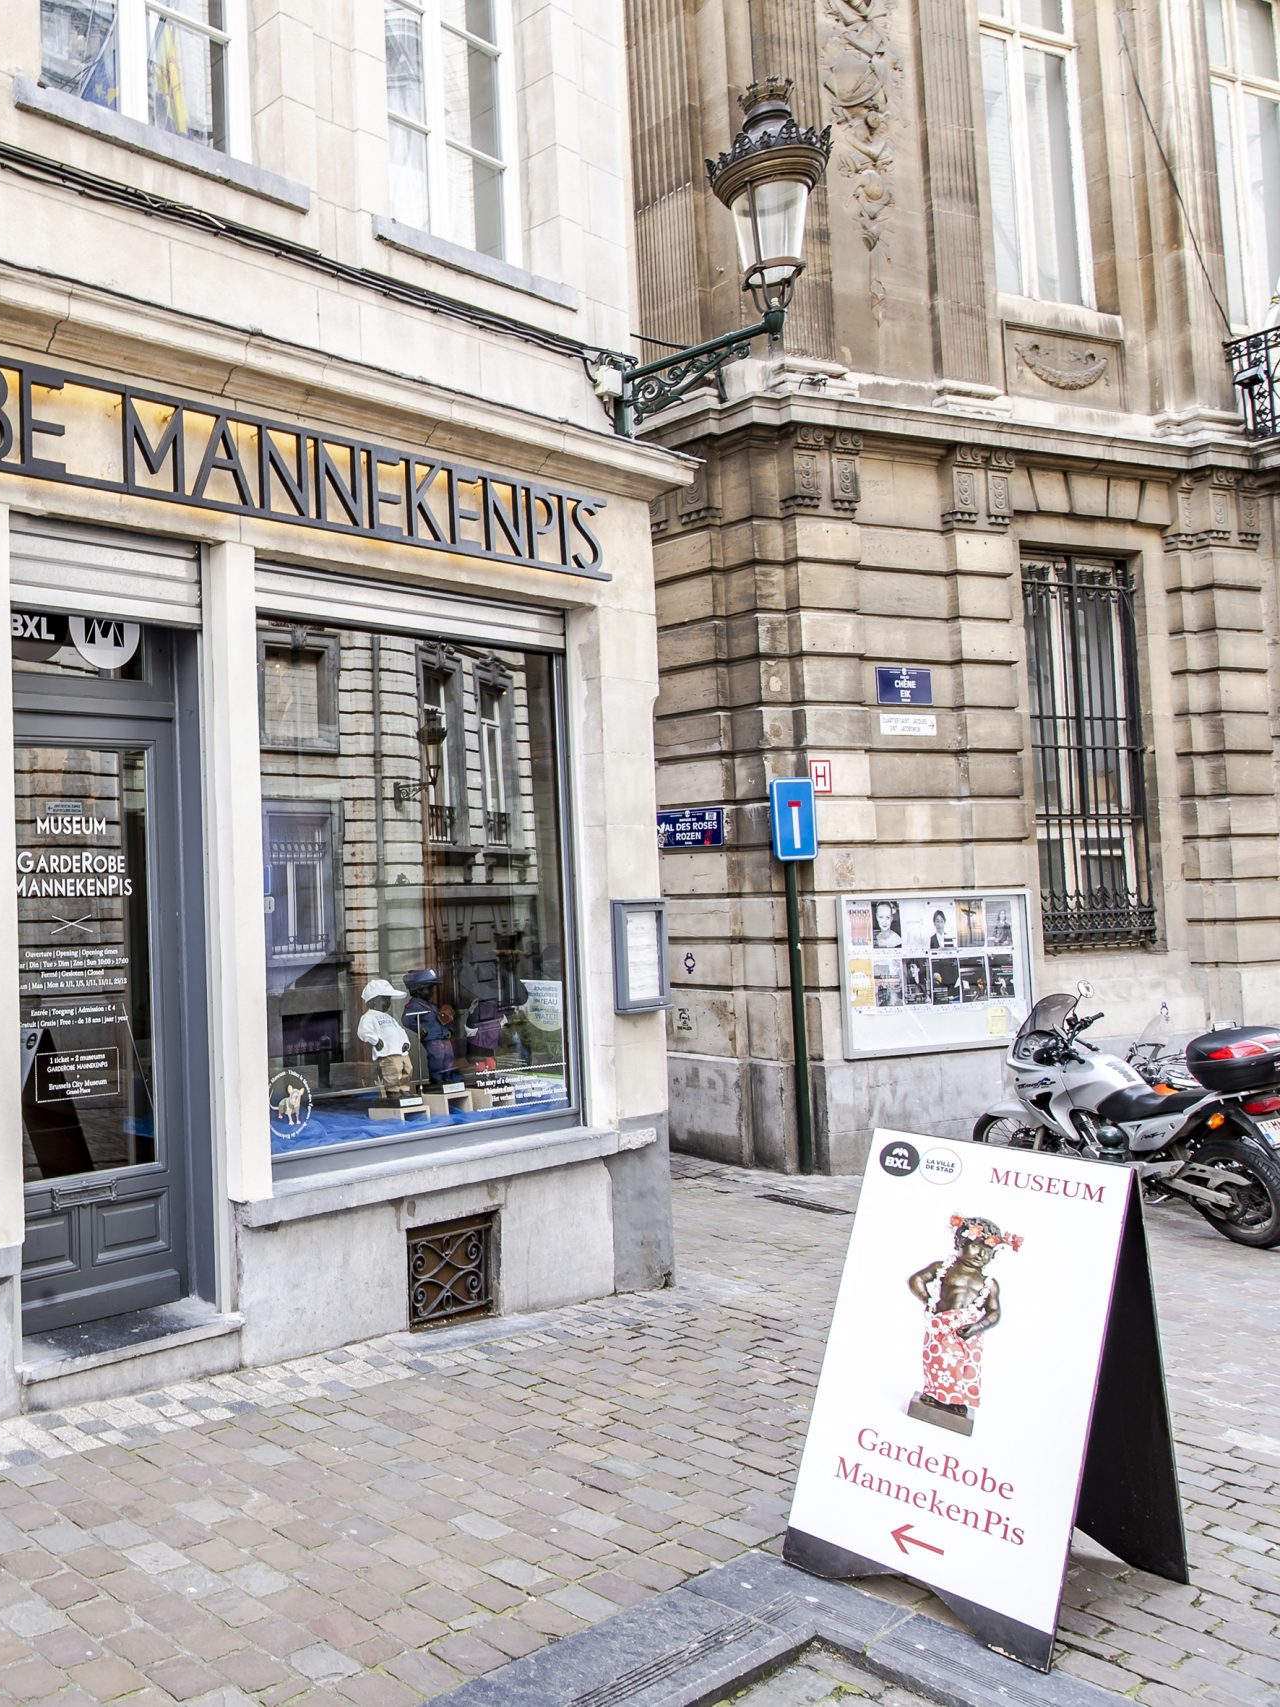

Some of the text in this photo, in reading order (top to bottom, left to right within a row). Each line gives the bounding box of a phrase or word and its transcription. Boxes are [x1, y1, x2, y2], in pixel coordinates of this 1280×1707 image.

[122, 386, 609, 577] MANNEKENPIS
[11, 613, 55, 640] BXL
[900, 689, 911, 698] EIK
[815, 766, 826, 787] H
[36, 816, 106, 835] MUSEUM
[676, 822, 691, 832] DES
[692, 821, 718, 831] ROSES
[676, 832, 702, 841] ROZEN
[25, 950, 53, 958] Ouverture
[56, 950, 78, 958] Opening
[81, 949, 103, 957] Opening
[884, 1155, 912, 1171] BXL
[936, 1160, 956, 1169] VILLE
[936, 1166, 954, 1174] STAD
[989, 1167, 1108, 1204] MUSEUM
[857, 1427, 1015, 1500] GardeRobe
[833, 1455, 1025, 1546] MannekenPis
